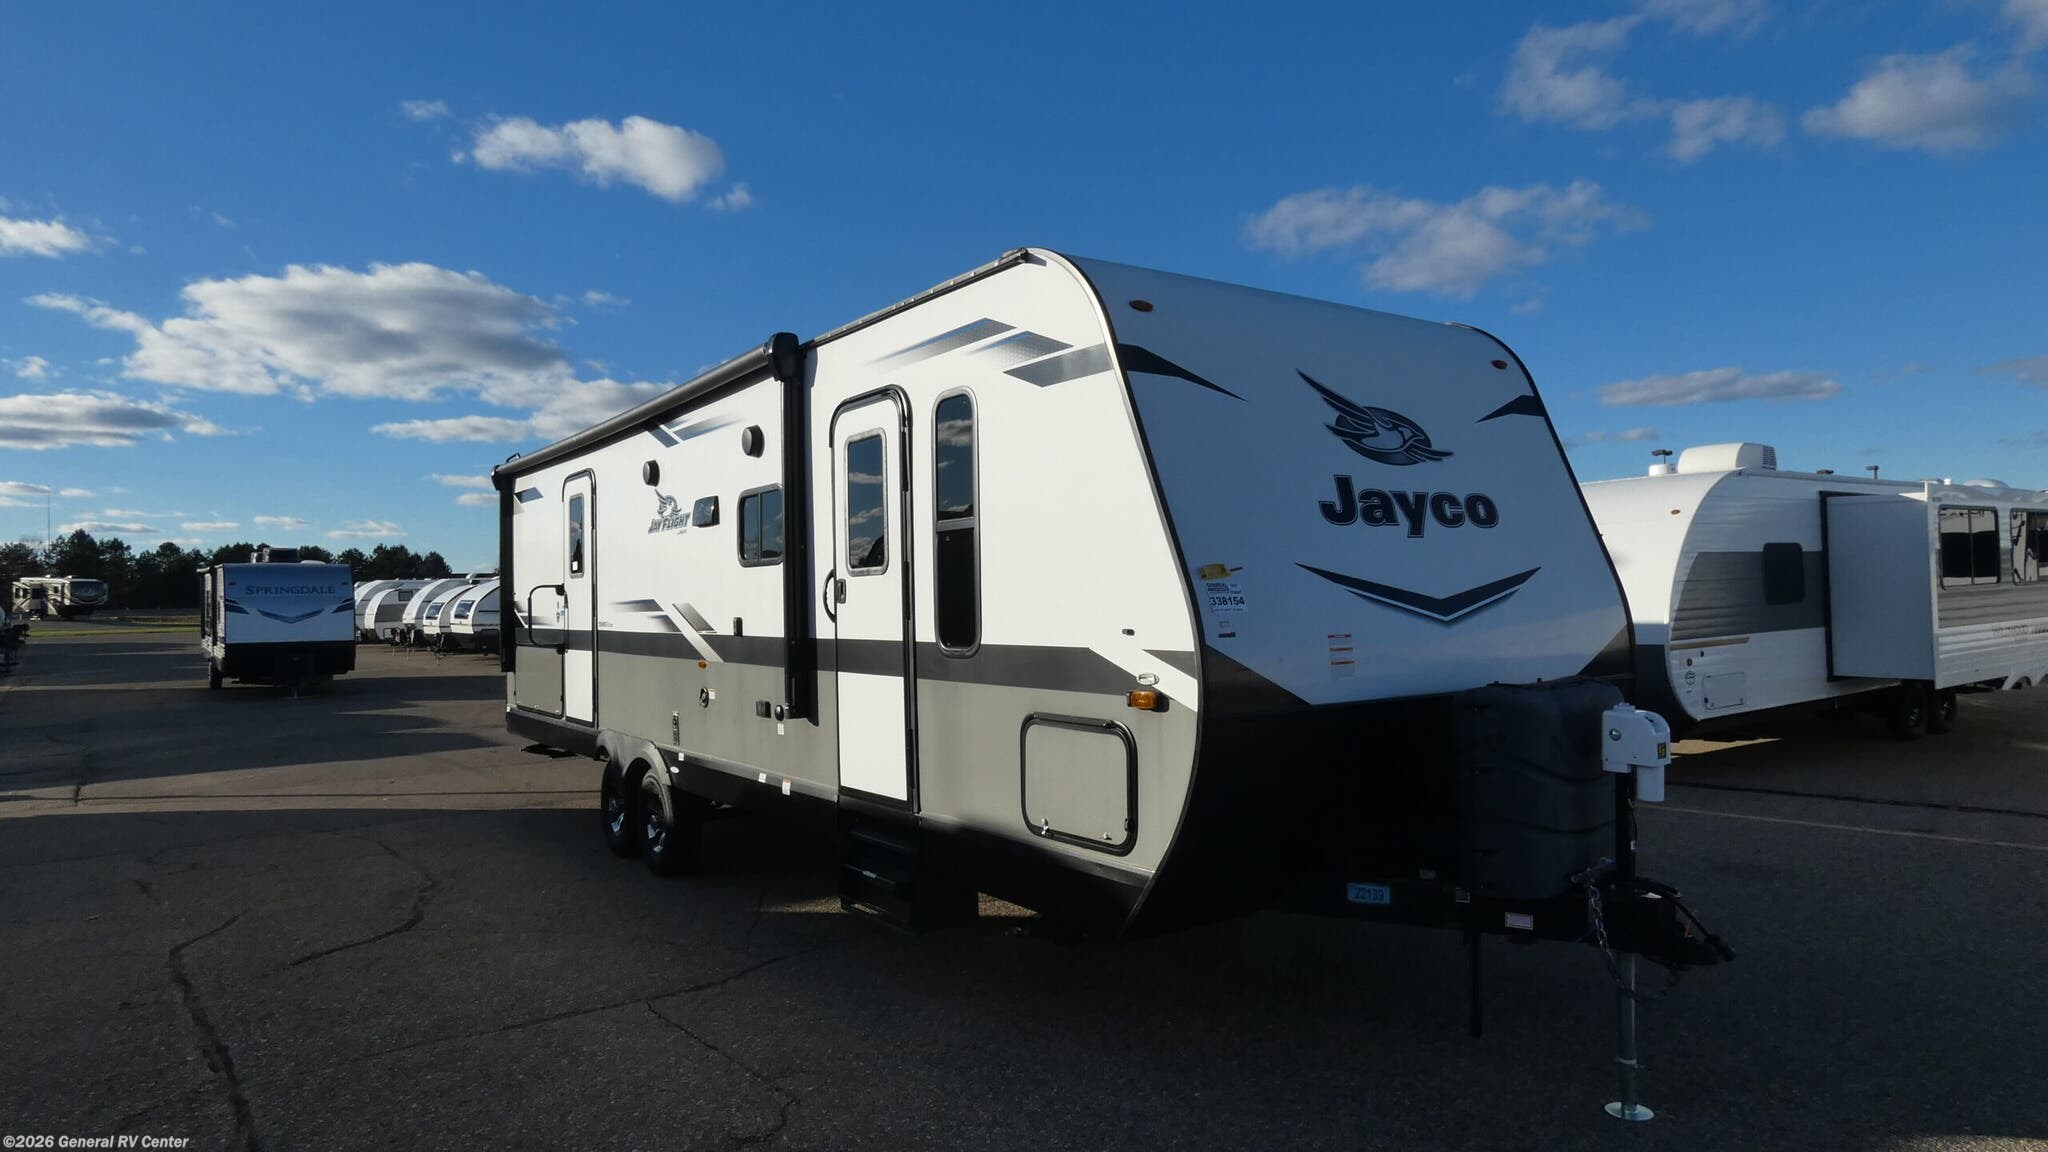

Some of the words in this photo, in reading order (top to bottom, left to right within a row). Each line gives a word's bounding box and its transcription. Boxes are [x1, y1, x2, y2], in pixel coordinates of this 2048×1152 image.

[1318, 474, 1500, 539] Jayco
[648, 518, 663, 535] JAY
[661, 512, 691, 532] FLIGHT
[245, 585, 336, 596] SPRINGDALE
[1209, 596, 1246, 606] 338154
